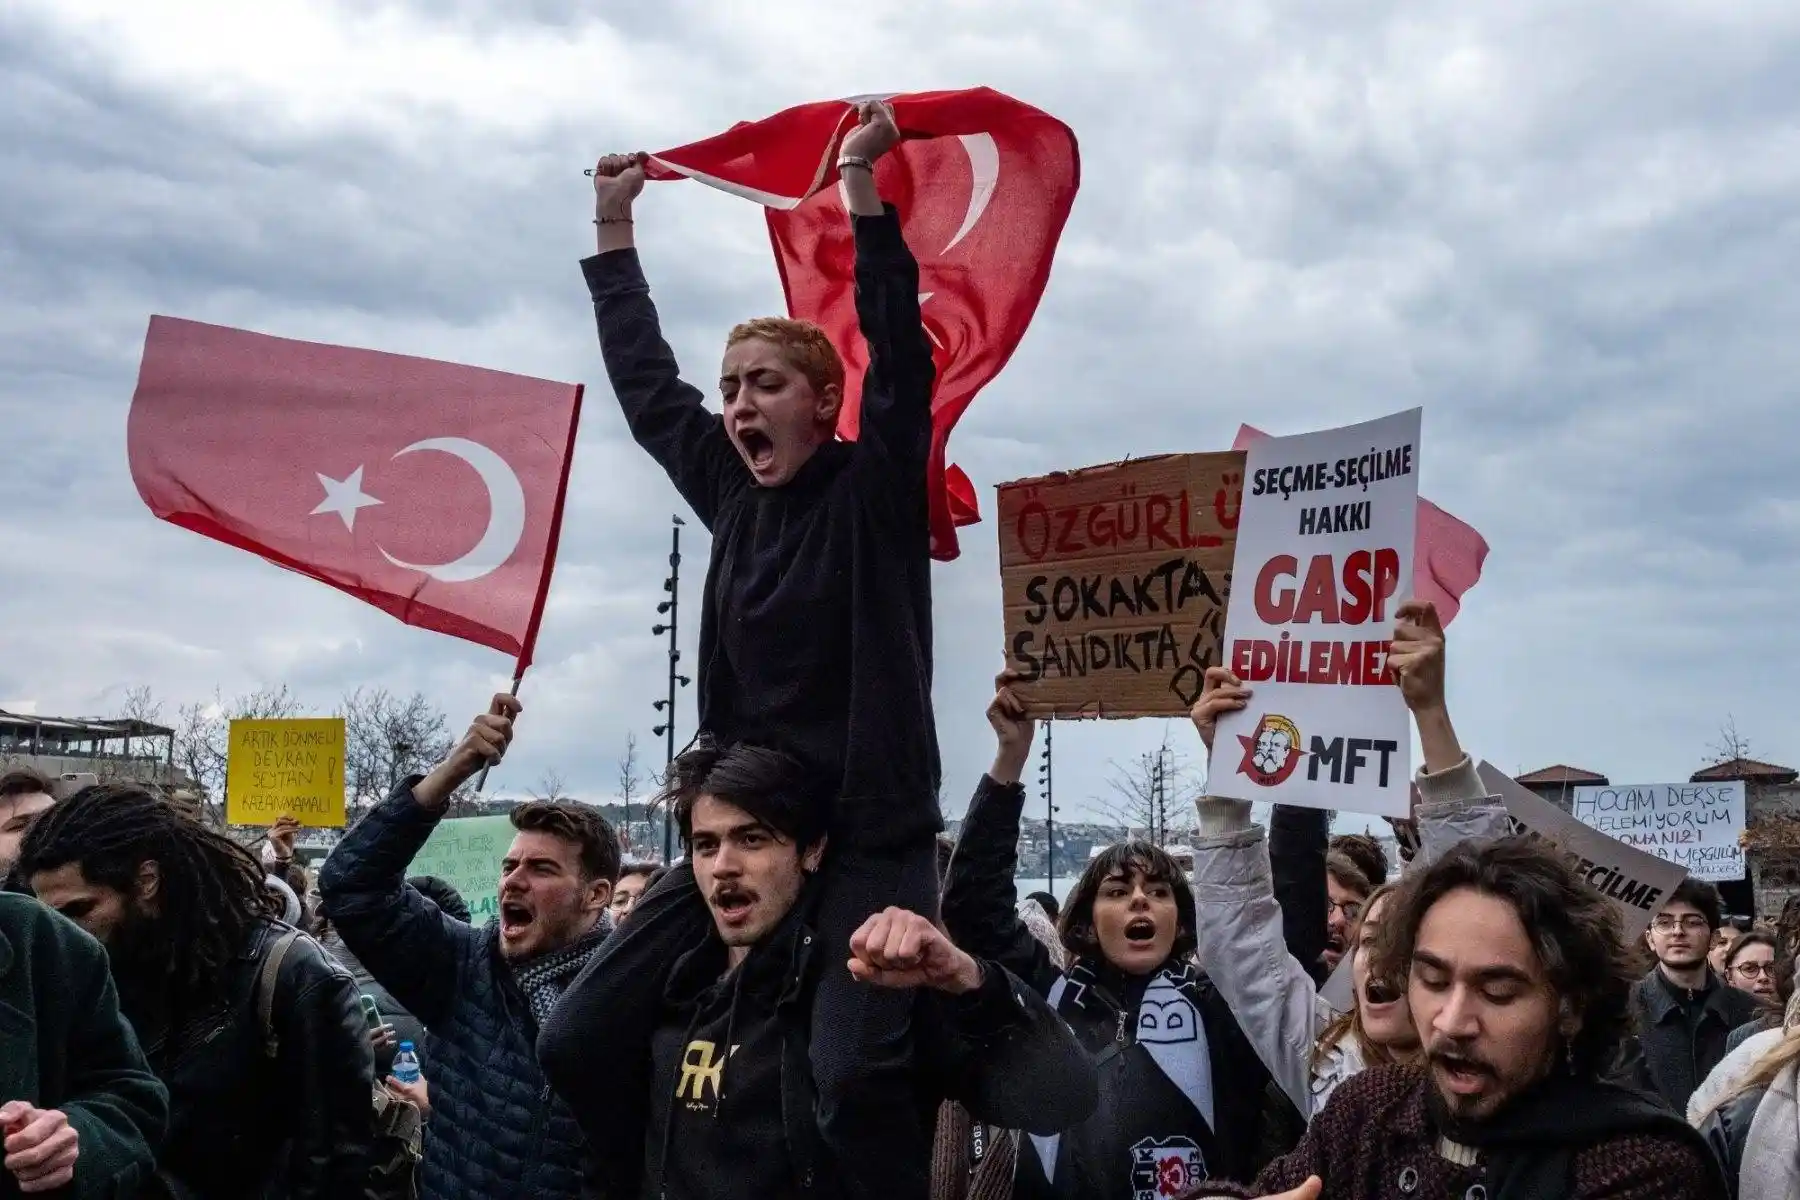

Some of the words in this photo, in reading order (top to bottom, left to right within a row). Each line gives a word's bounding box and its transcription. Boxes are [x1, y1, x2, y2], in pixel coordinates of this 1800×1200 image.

[1252, 444, 1412, 500] SEÇME-SEÇİLME
[1299, 501, 1371, 535] HAKKI
[1254, 547, 1400, 626] GASP
[1307, 735, 1398, 788] MFT
[1575, 788, 1656, 818] HOCAM
[1667, 786, 1733, 809] DERSE
